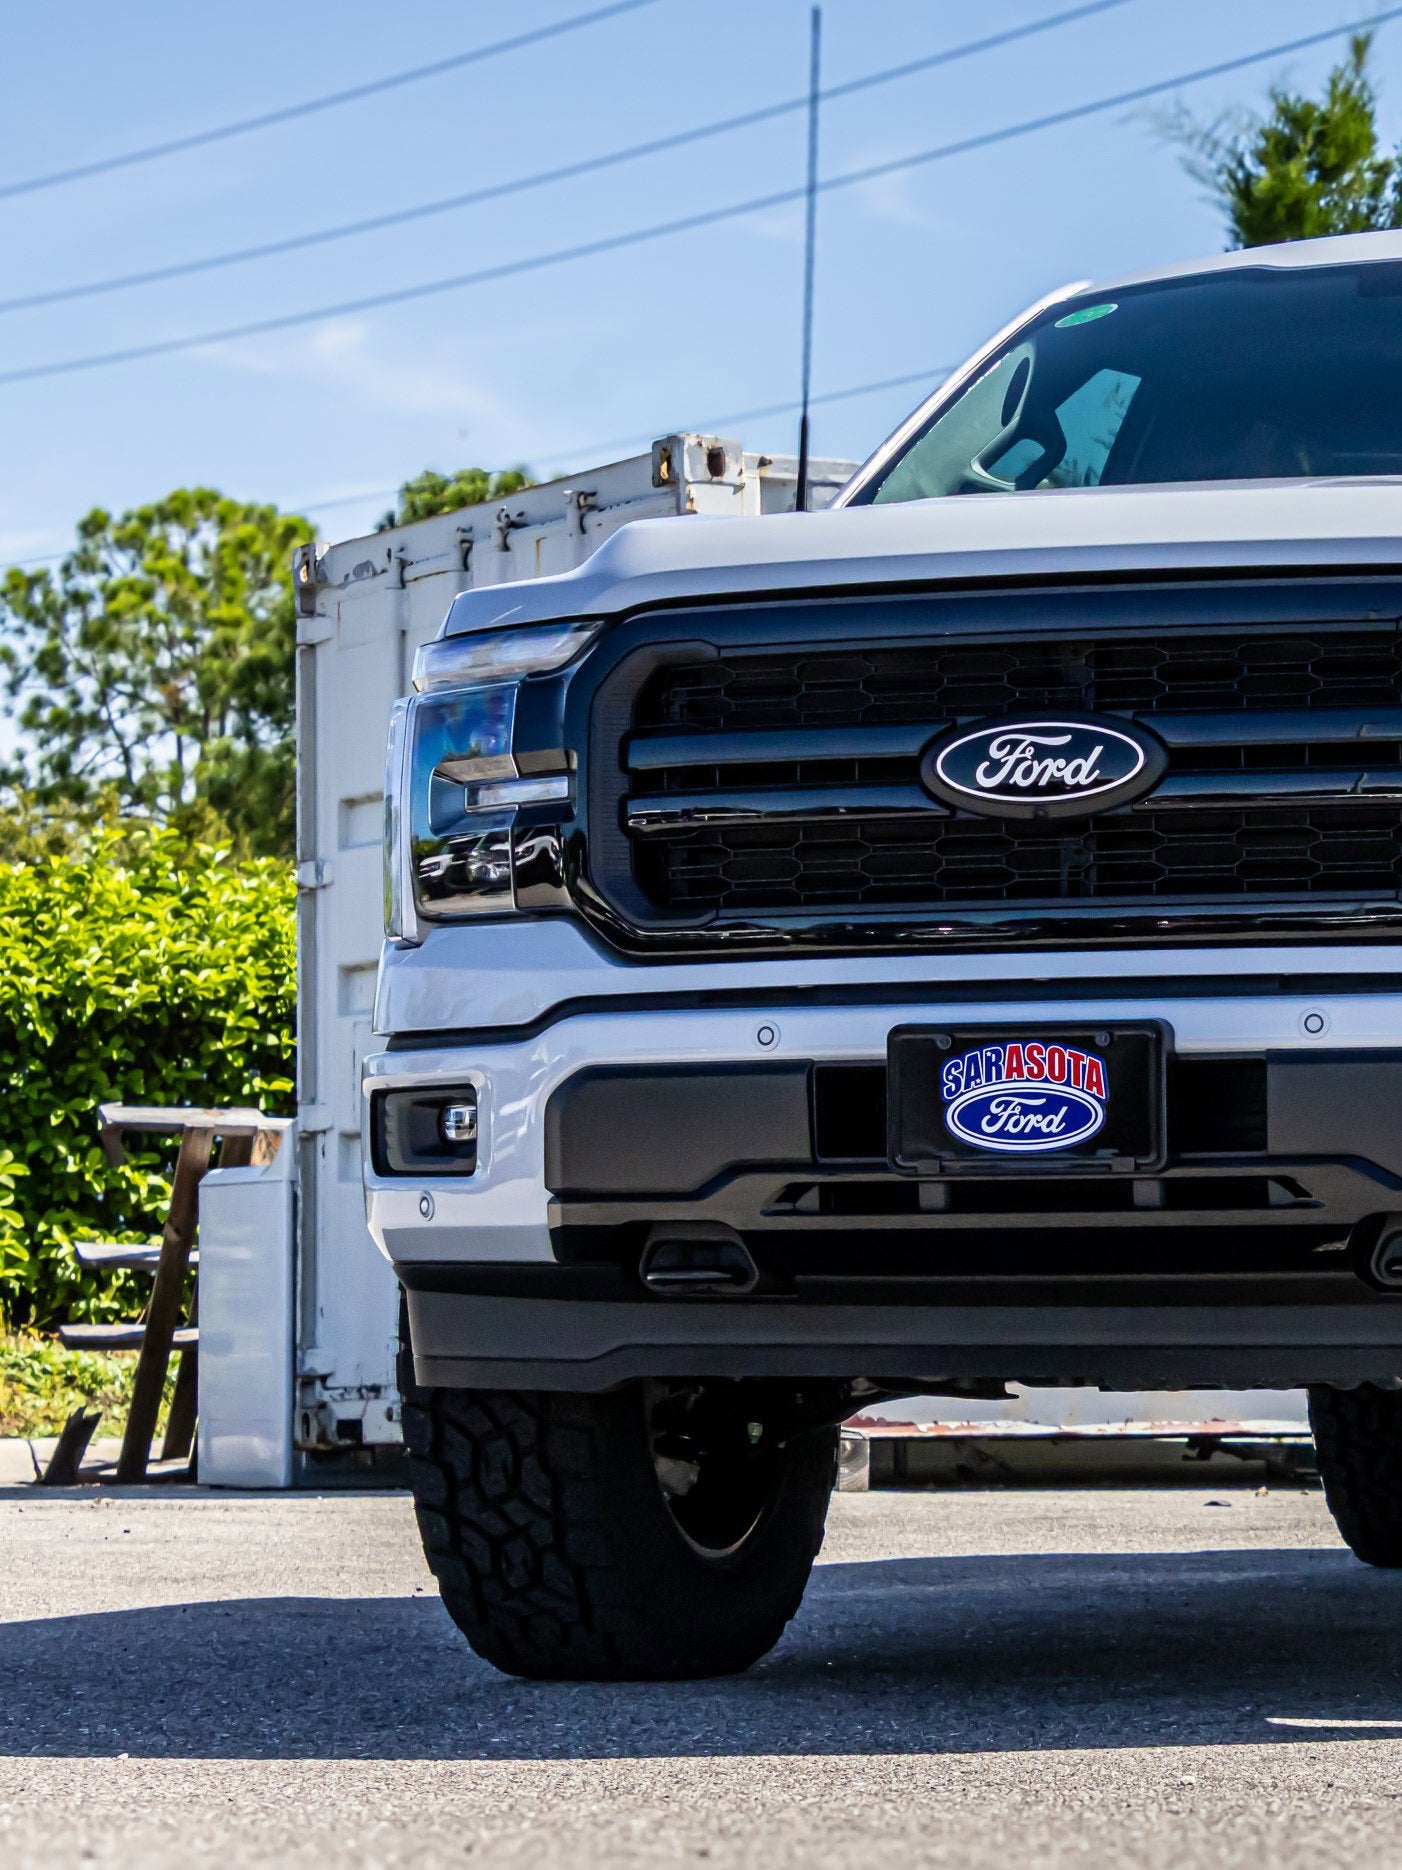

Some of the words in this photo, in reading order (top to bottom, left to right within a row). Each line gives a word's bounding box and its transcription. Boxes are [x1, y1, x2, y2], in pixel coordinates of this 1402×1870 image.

[976, 734, 1104, 788] Ford
[943, 1043, 1106, 1100] SARASOTA
[981, 1096, 1069, 1134] Ford
